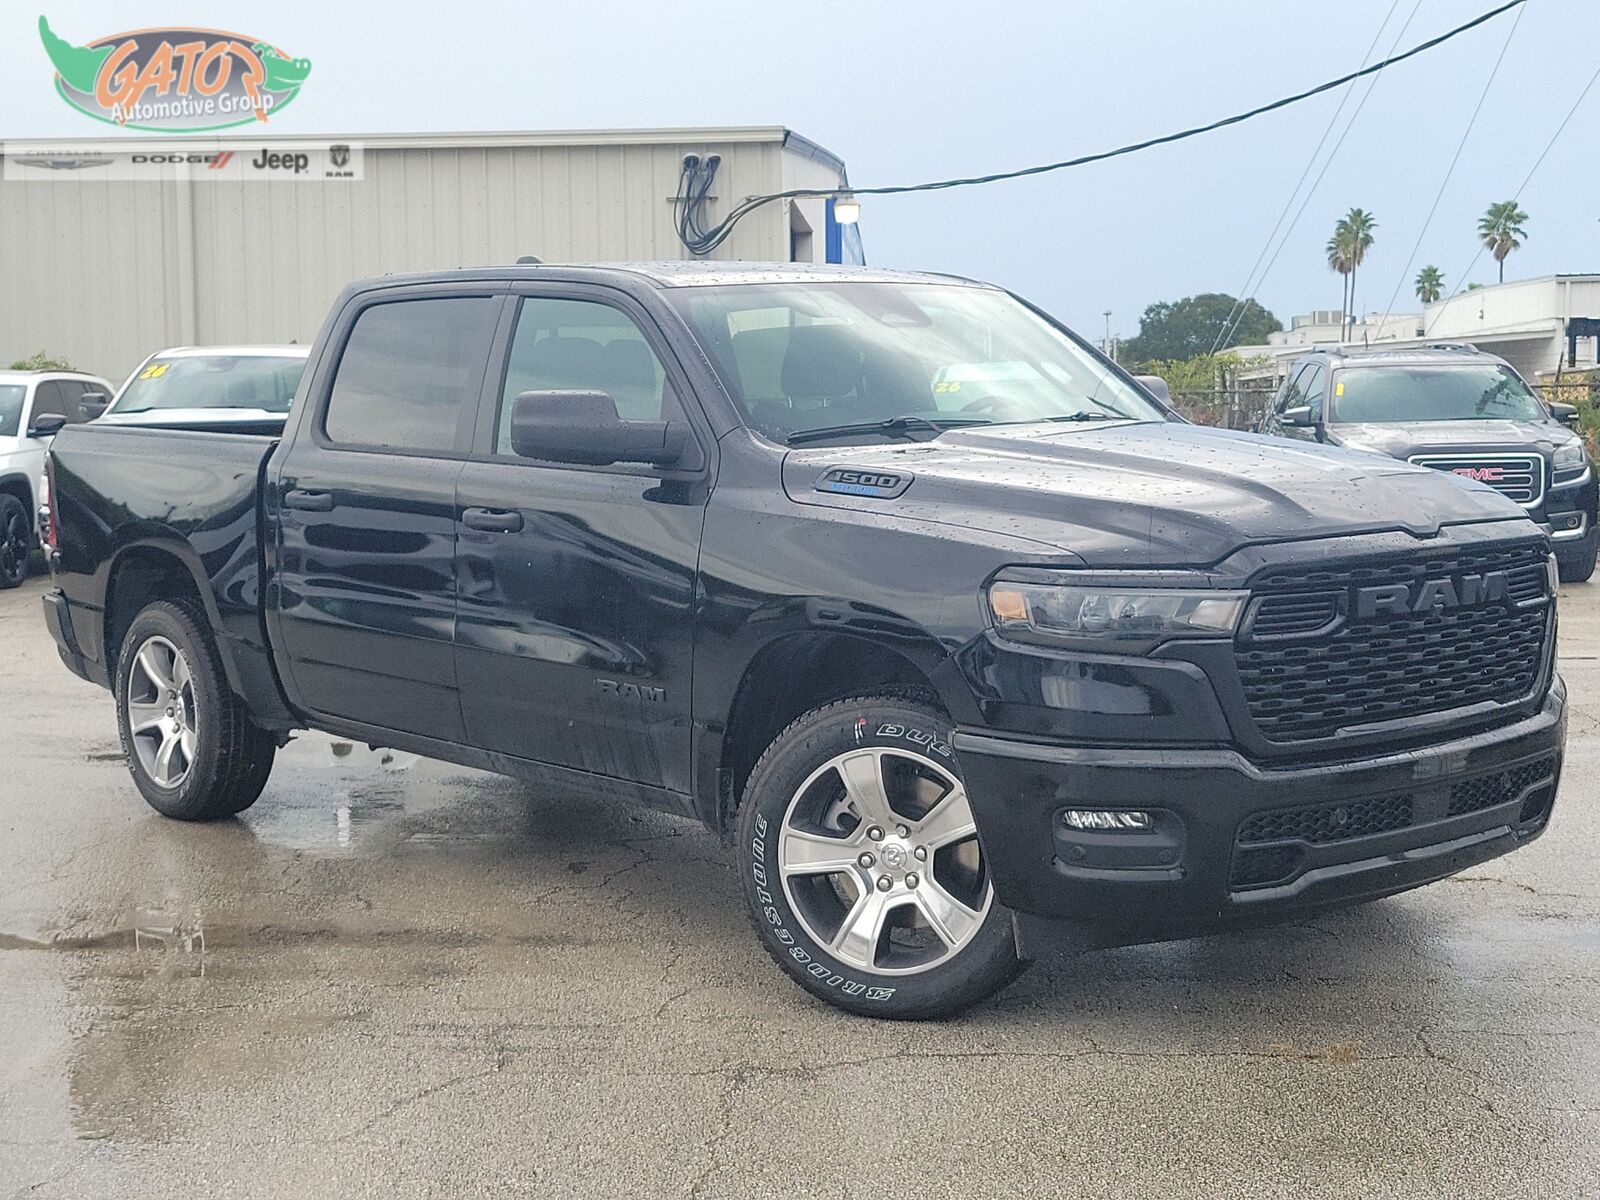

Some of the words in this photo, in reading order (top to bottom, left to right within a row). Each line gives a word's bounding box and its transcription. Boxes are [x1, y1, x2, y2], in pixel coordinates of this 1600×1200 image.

[934, 381, 961, 393] 26
[830, 470, 899, 488] 1500
[1452, 467, 1504, 481] GMC
[1358, 570, 1510, 618] RAM
[593, 679, 666, 702] RAM
[876, 723, 953, 757] DUE
[752, 813, 896, 1001] BRIDGESTONE
